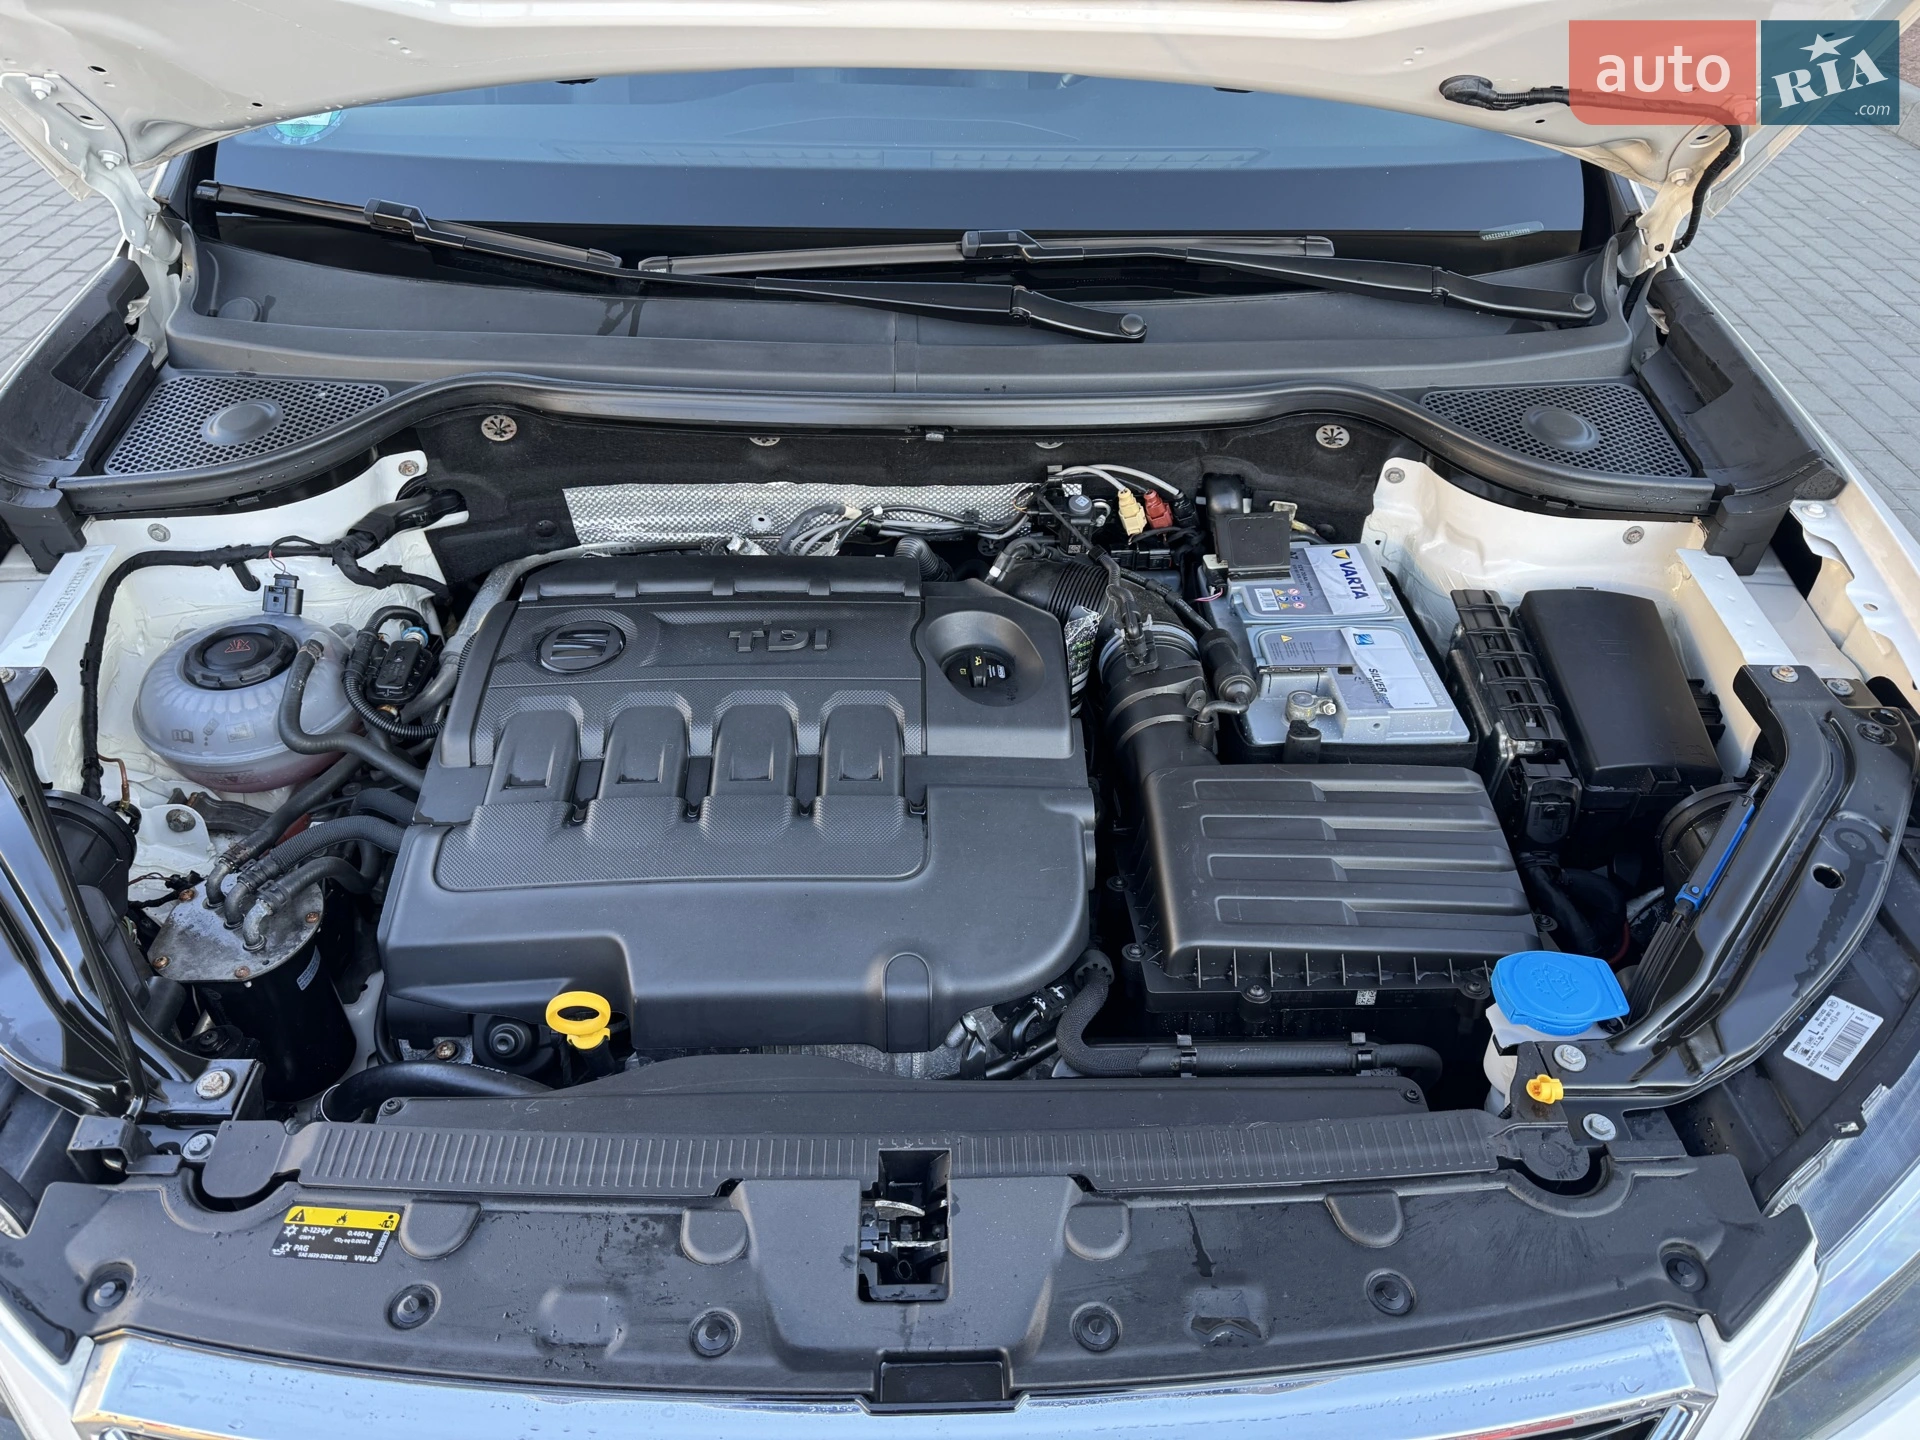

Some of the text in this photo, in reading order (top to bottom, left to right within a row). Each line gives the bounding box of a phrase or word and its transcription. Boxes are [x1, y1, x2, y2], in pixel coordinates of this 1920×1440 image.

[1339, 561, 1369, 599] VARTA
[728, 629, 831, 652] TDI
[1368, 668, 1388, 692] SILVER
[302, 1226, 333, 1236] R-1234yf
[293, 1244, 309, 1252] PAG
